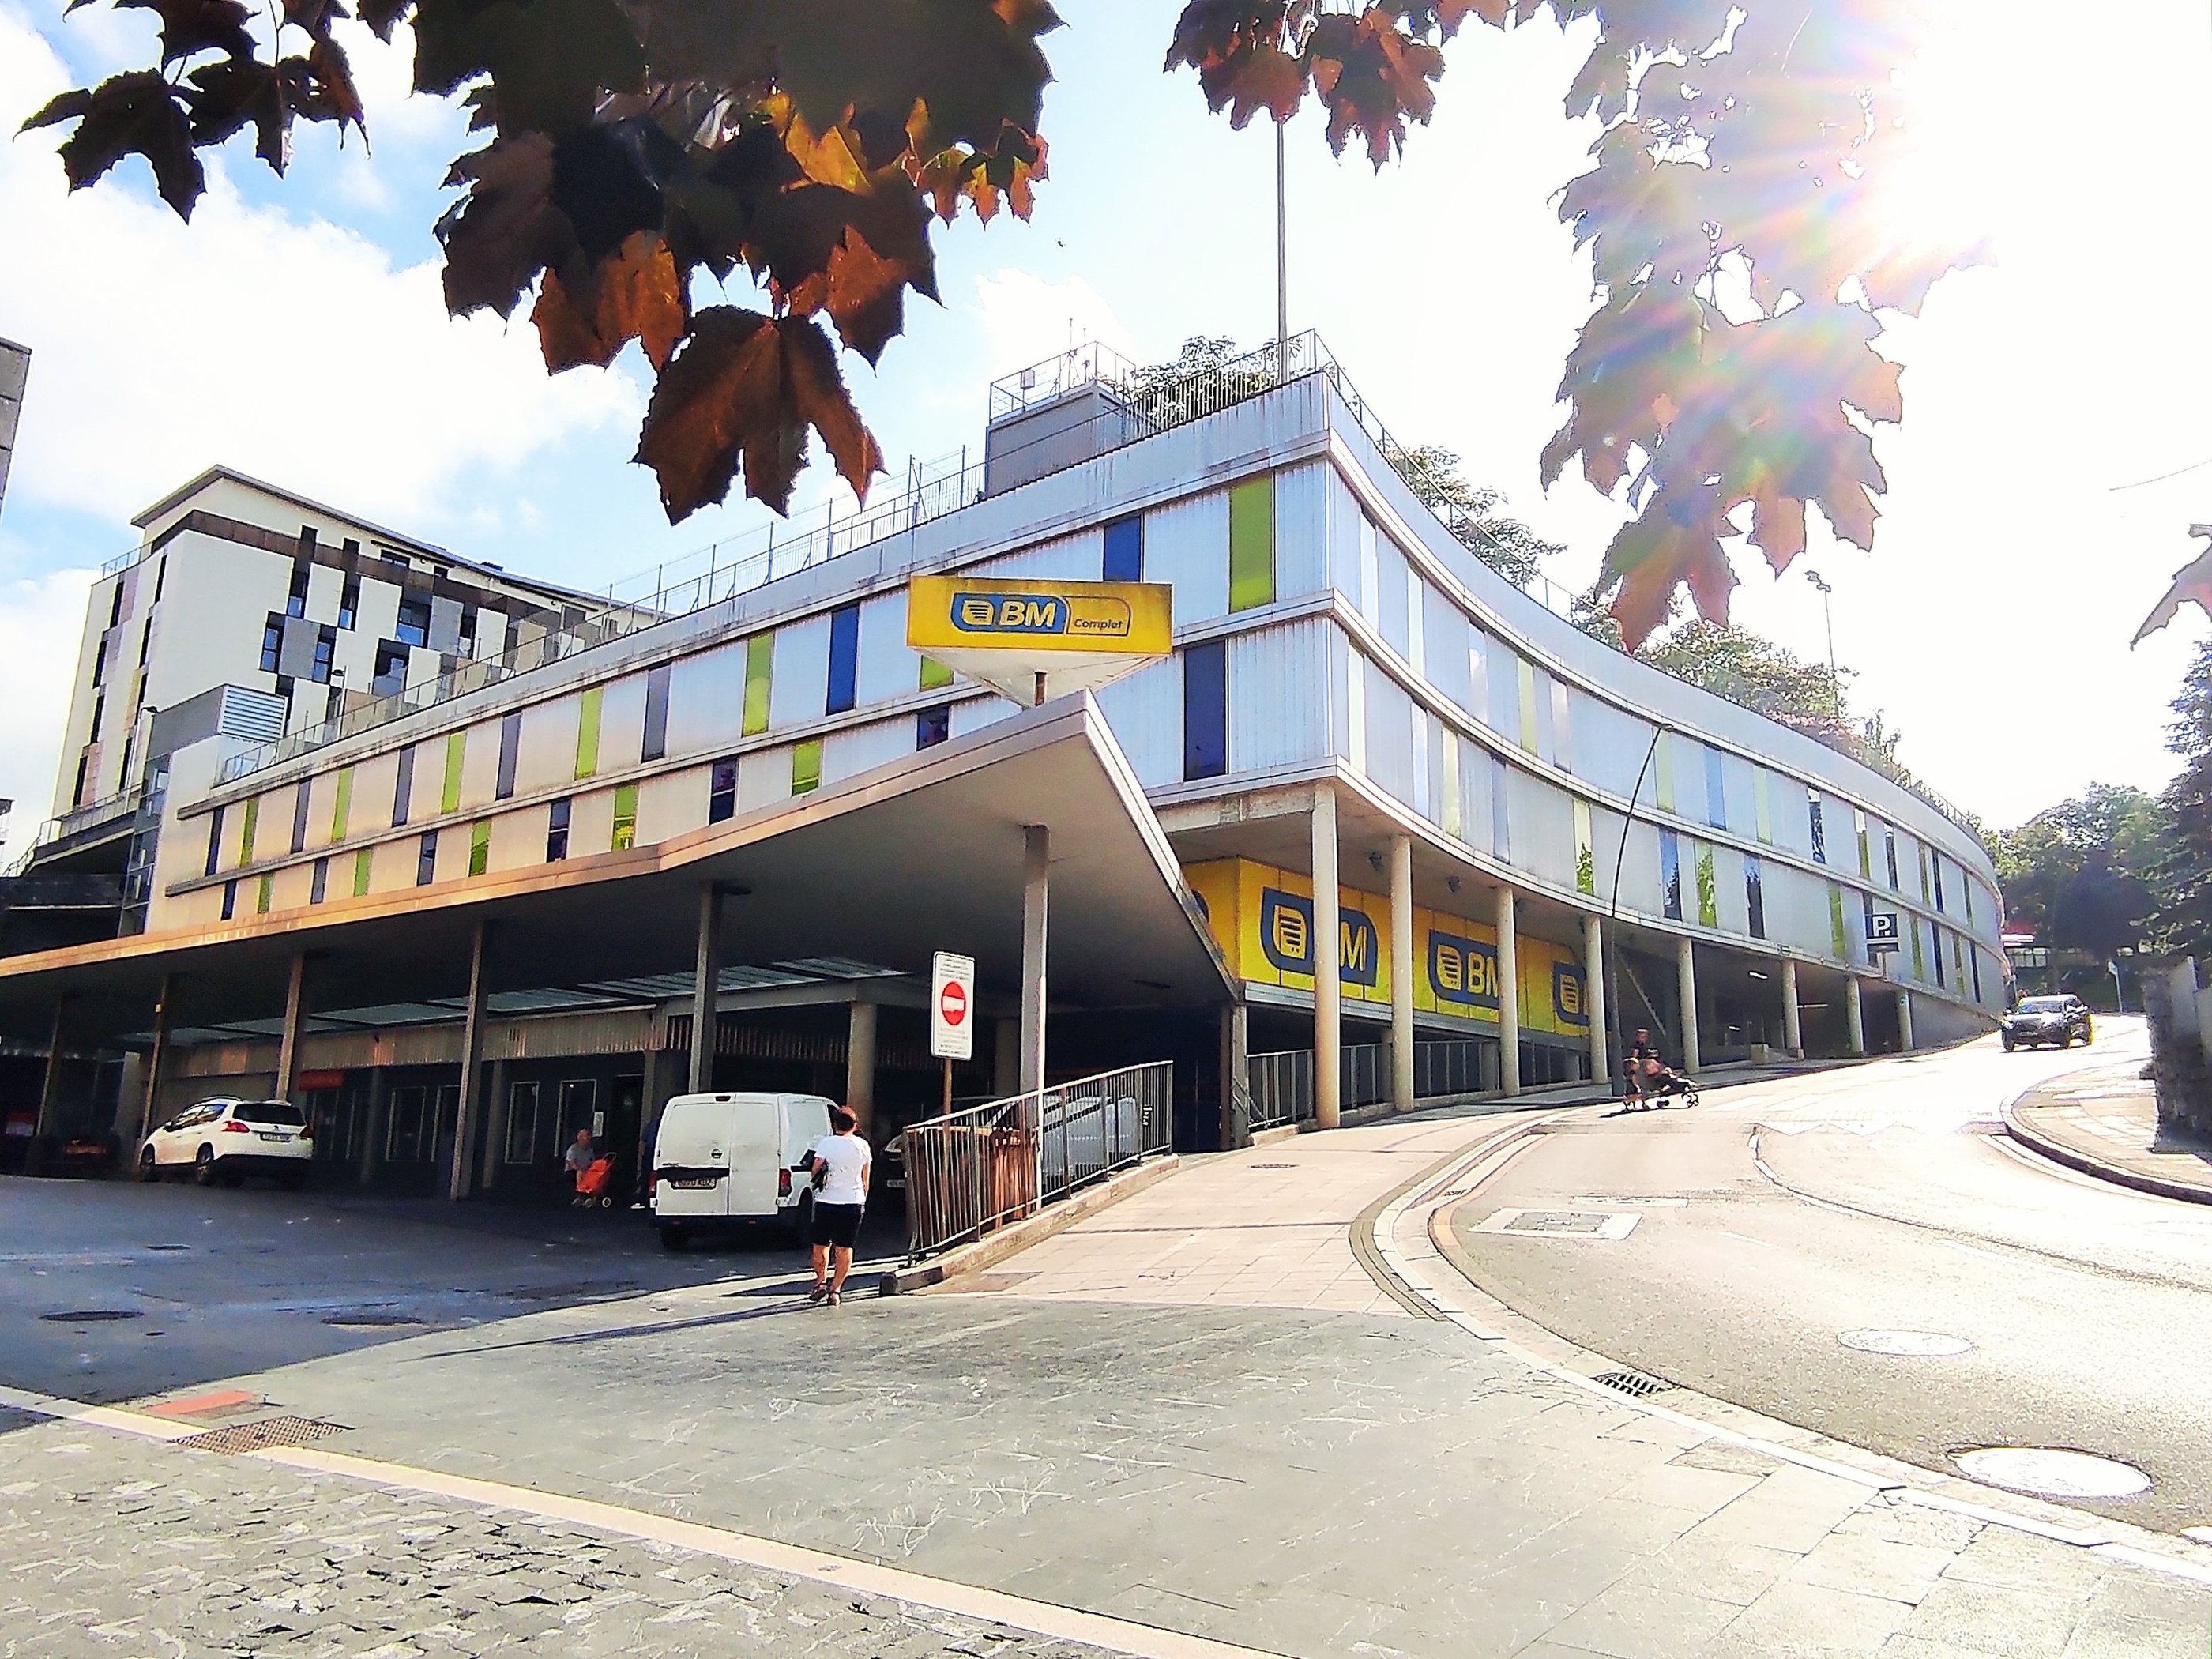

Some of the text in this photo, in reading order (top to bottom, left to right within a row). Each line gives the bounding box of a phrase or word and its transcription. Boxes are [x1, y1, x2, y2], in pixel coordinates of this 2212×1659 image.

[1000, 601, 1123, 632] BM Complet
[1872, 916, 1891, 937] P
[1340, 921, 1367, 972] M
